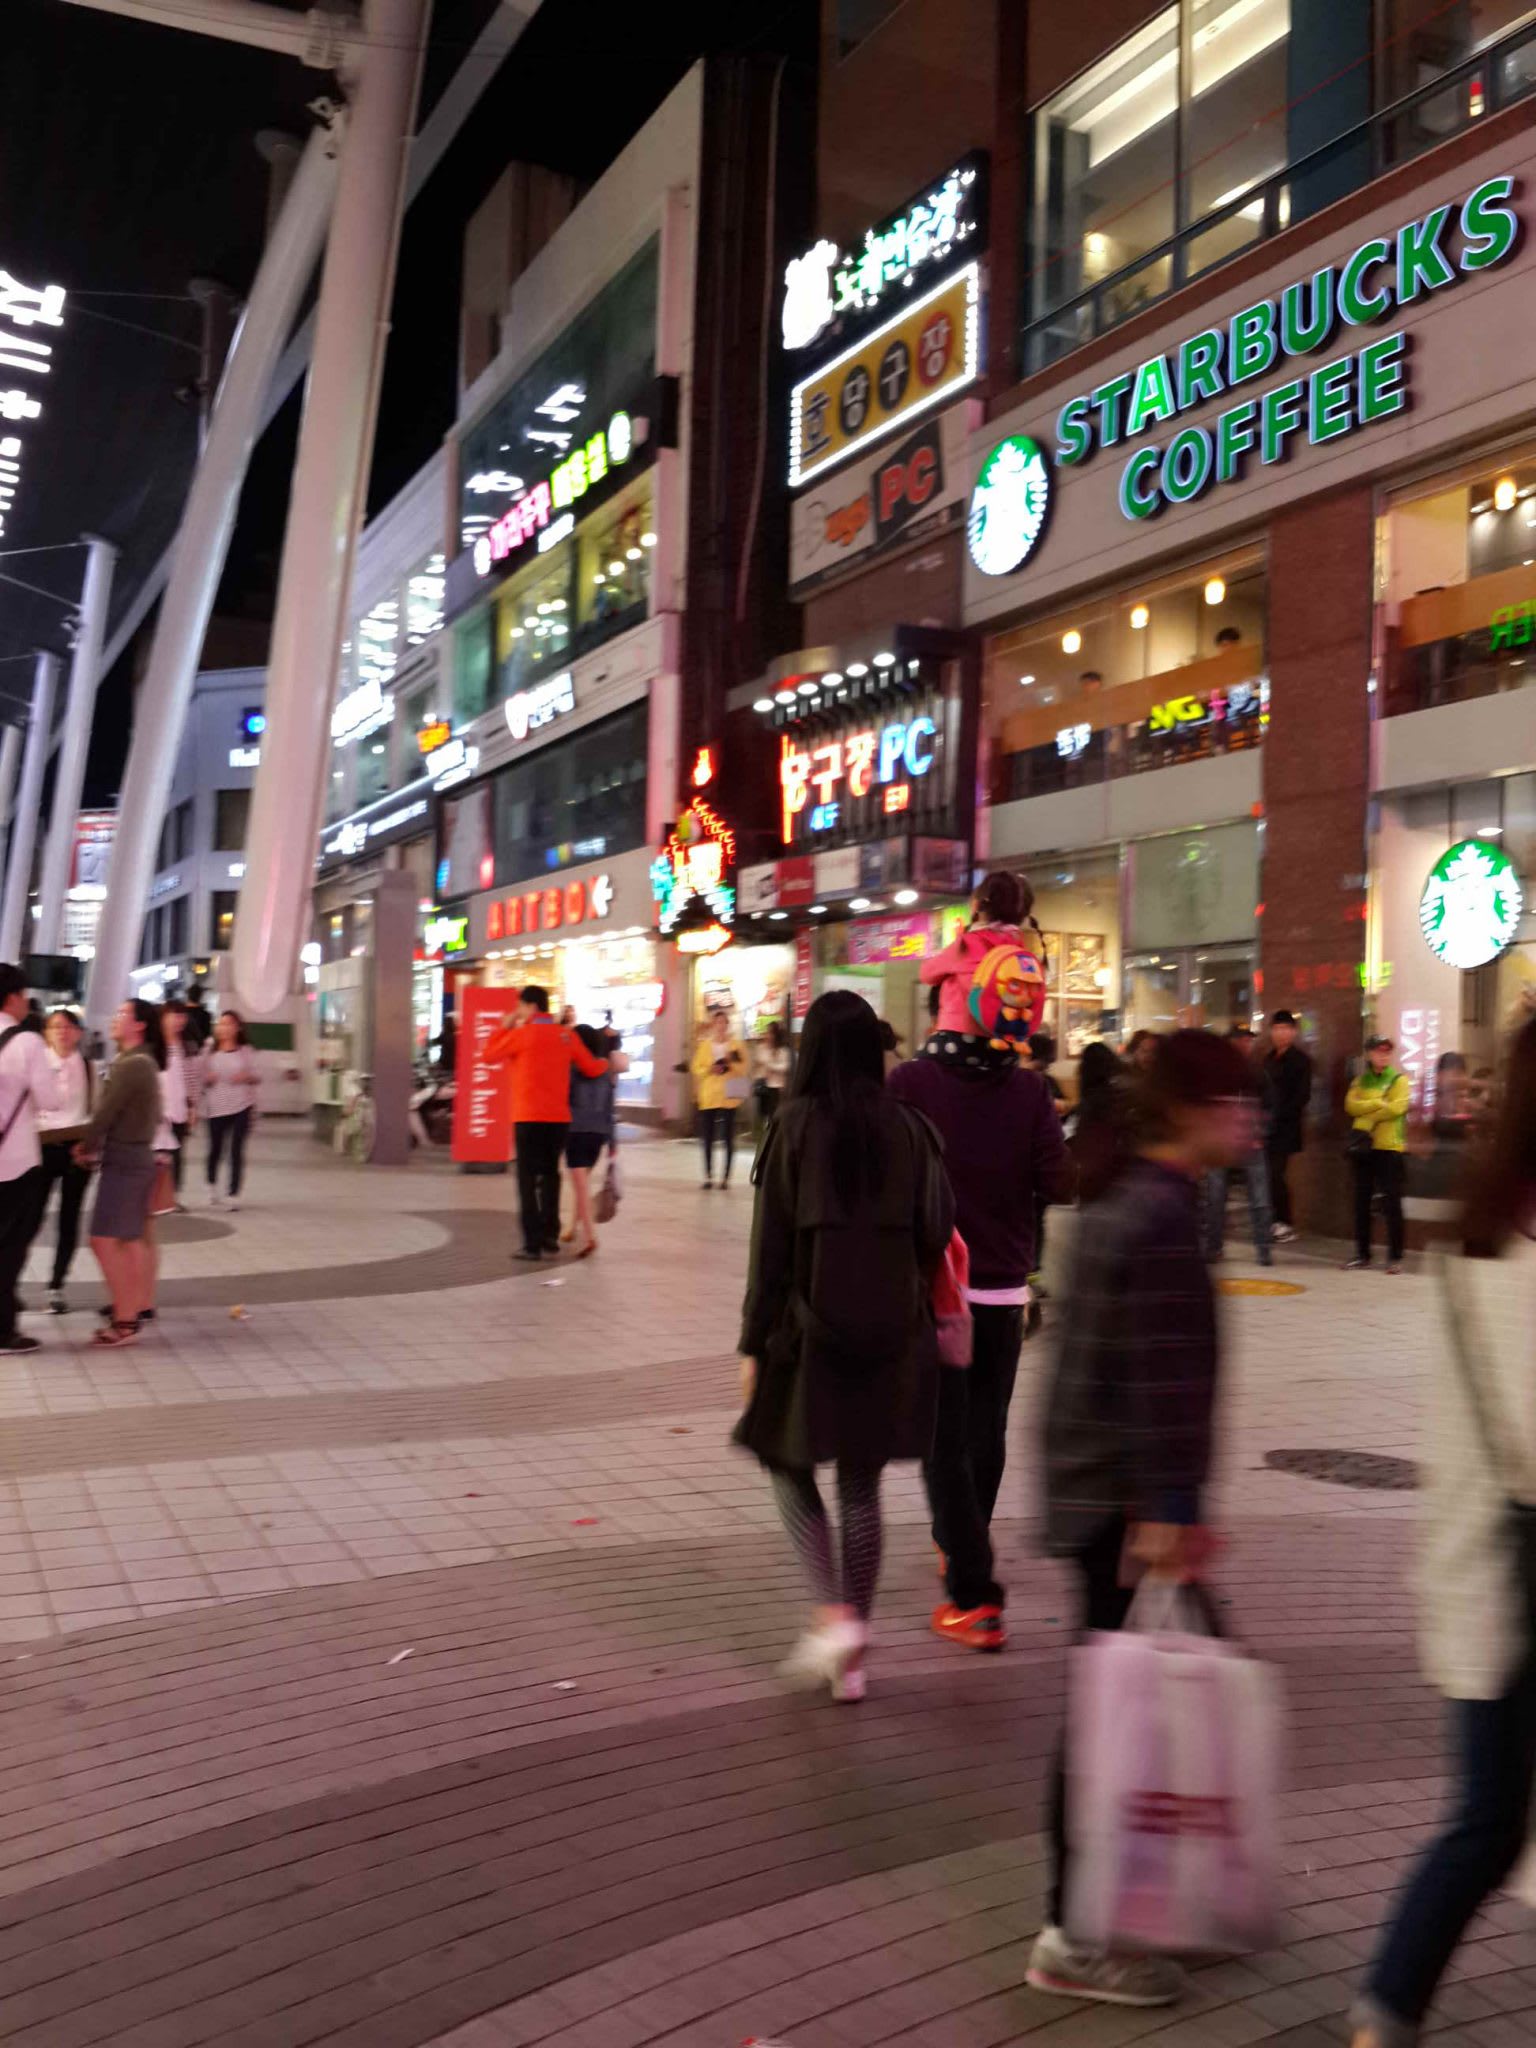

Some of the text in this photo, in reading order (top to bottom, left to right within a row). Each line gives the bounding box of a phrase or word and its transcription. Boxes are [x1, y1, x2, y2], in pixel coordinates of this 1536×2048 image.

[1055, 175, 1518, 468] STARBUCKS
[880, 446, 938, 523] PC
[1120, 332, 1407, 521] COFFEE
[880, 717, 936, 784] PC
